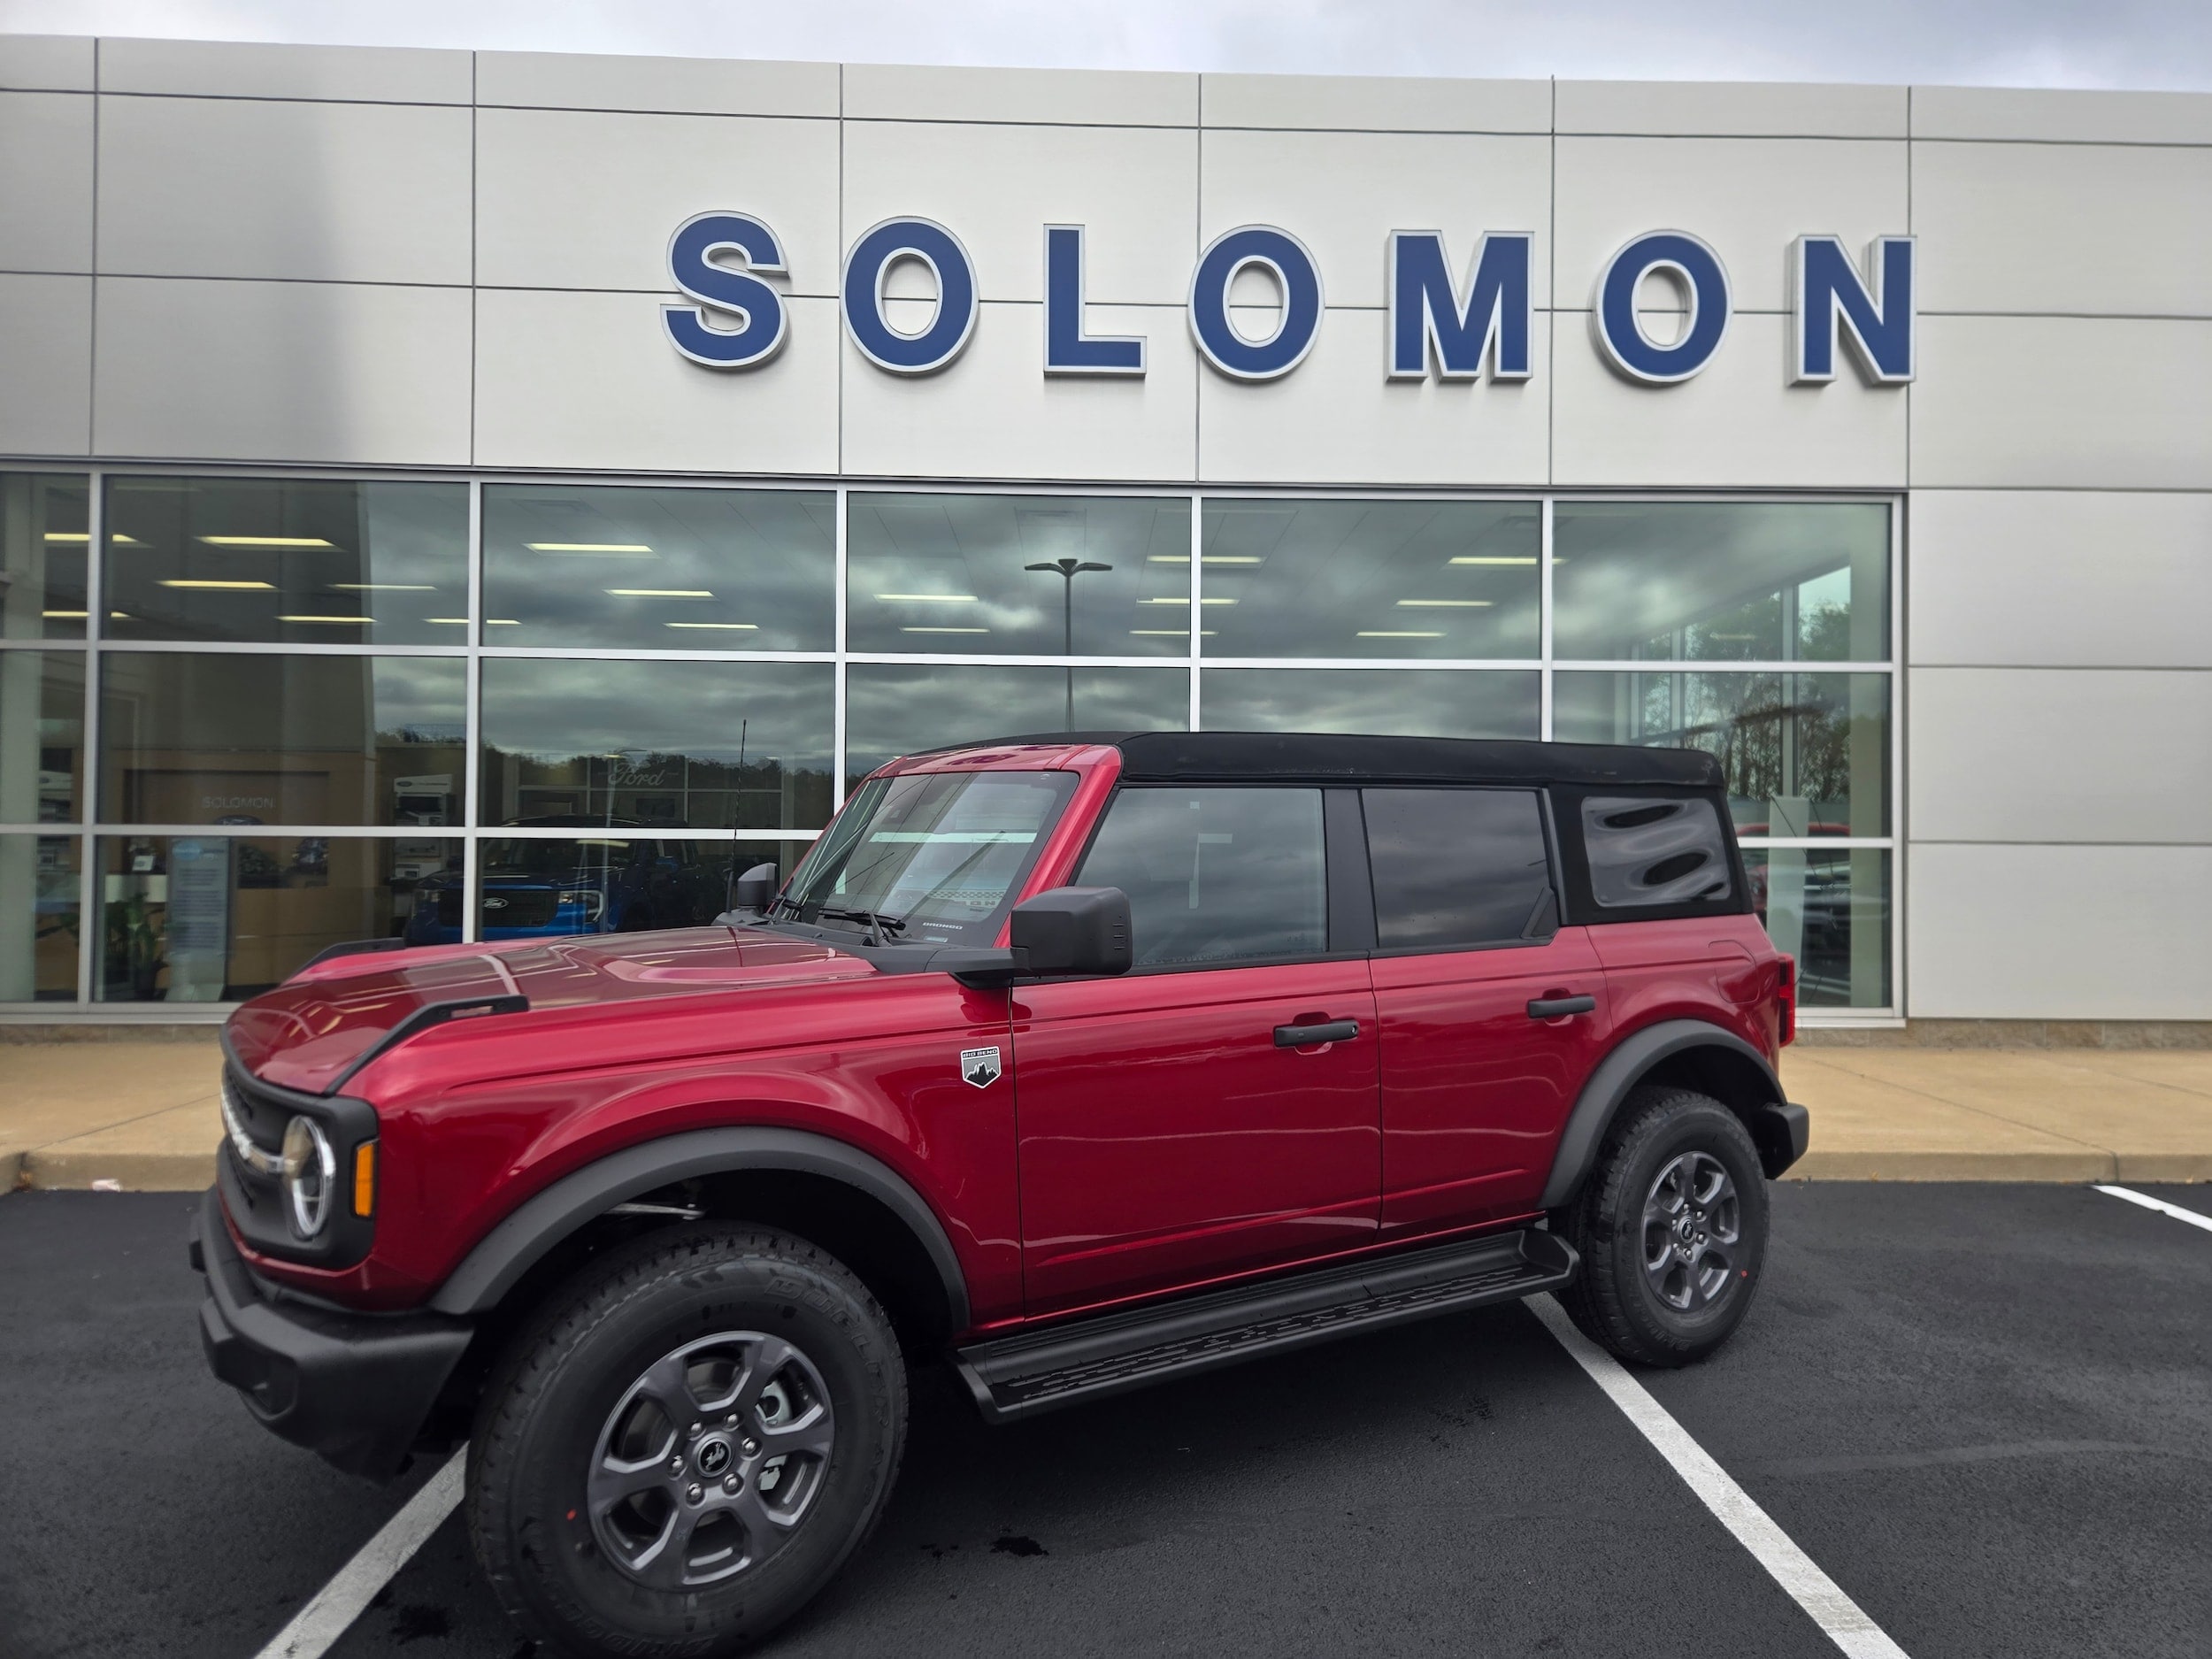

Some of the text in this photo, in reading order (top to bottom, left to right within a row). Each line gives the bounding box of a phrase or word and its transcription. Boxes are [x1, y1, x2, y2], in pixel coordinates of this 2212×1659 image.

[660, 211, 1916, 384] SOLOMON
[608, 762, 666, 787] Ford
[203, 796, 274, 809] SOLOMON
